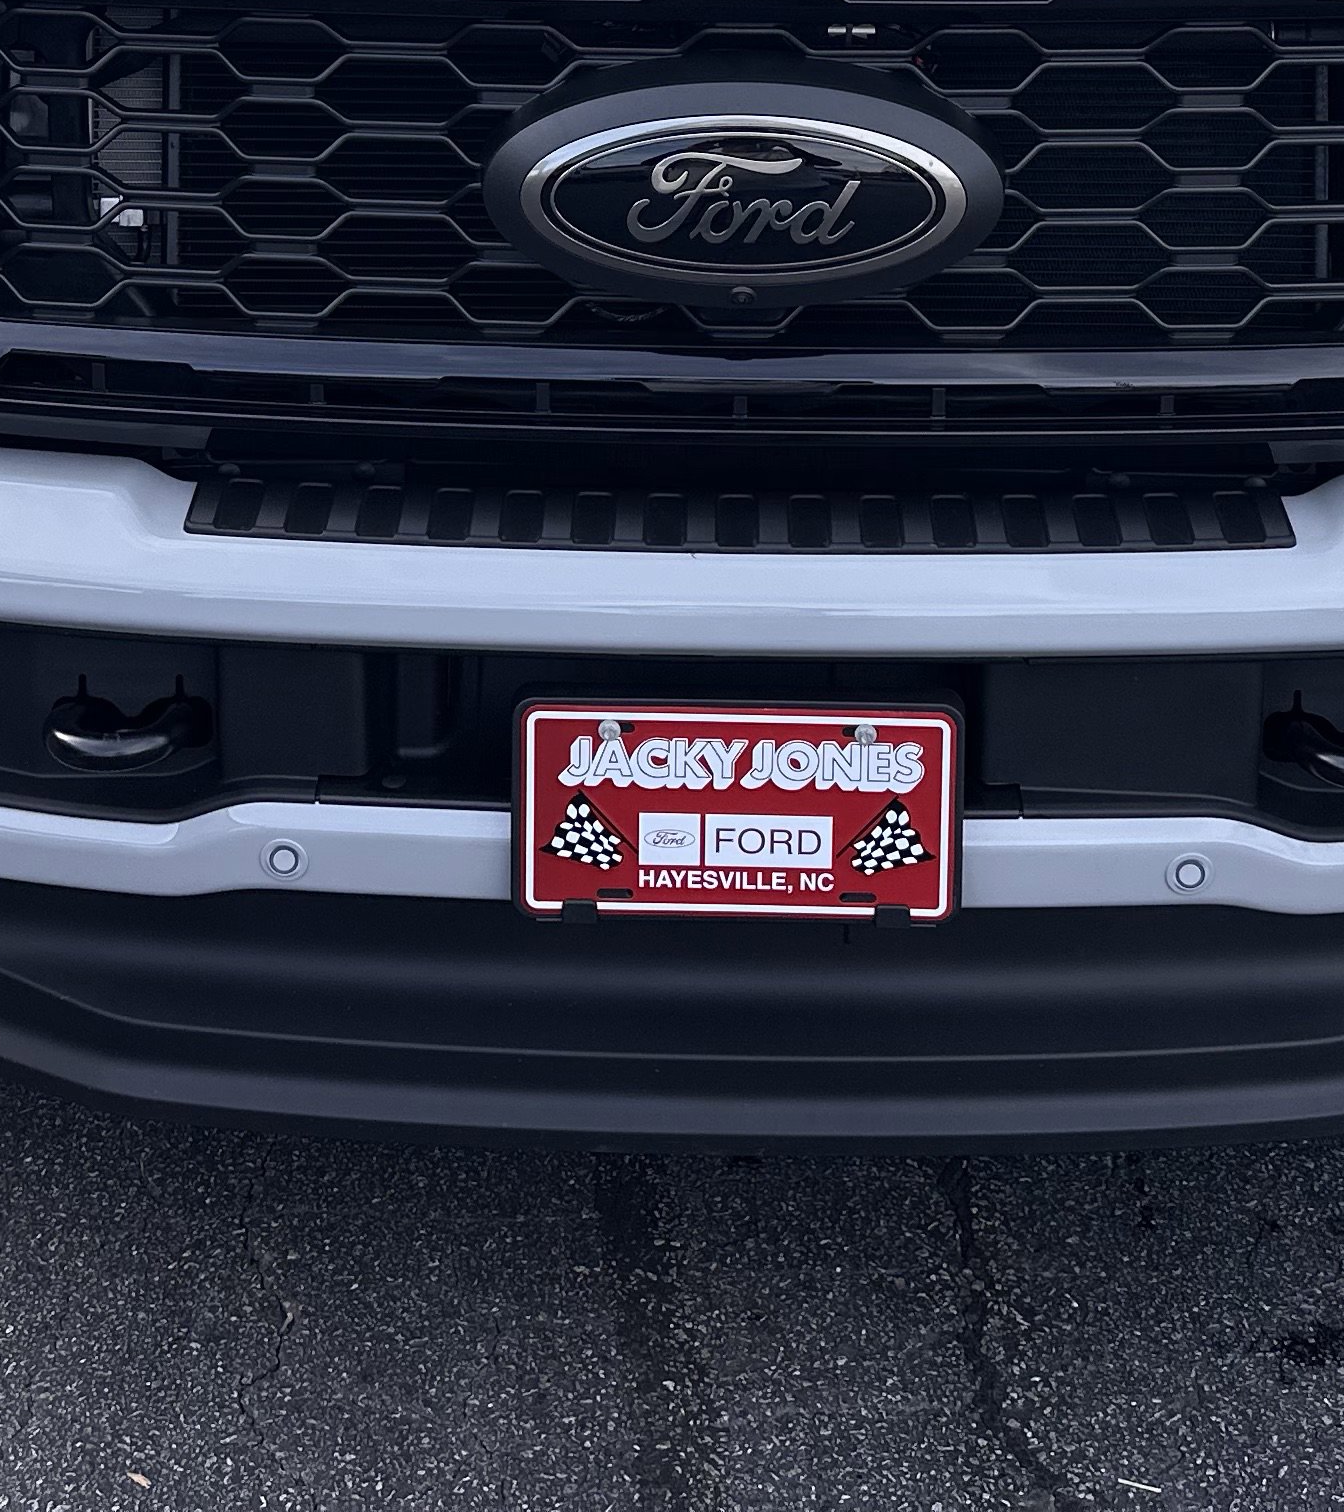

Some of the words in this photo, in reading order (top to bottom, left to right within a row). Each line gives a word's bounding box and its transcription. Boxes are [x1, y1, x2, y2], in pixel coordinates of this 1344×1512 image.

[626, 151, 862, 246] Ford
[558, 735, 750, 789] JACKY
[740, 739, 926, 795] JONES
[714, 827, 822, 856] FORD
[638, 869, 794, 894] HAYESVILLE,
[799, 872, 835, 892] NC
